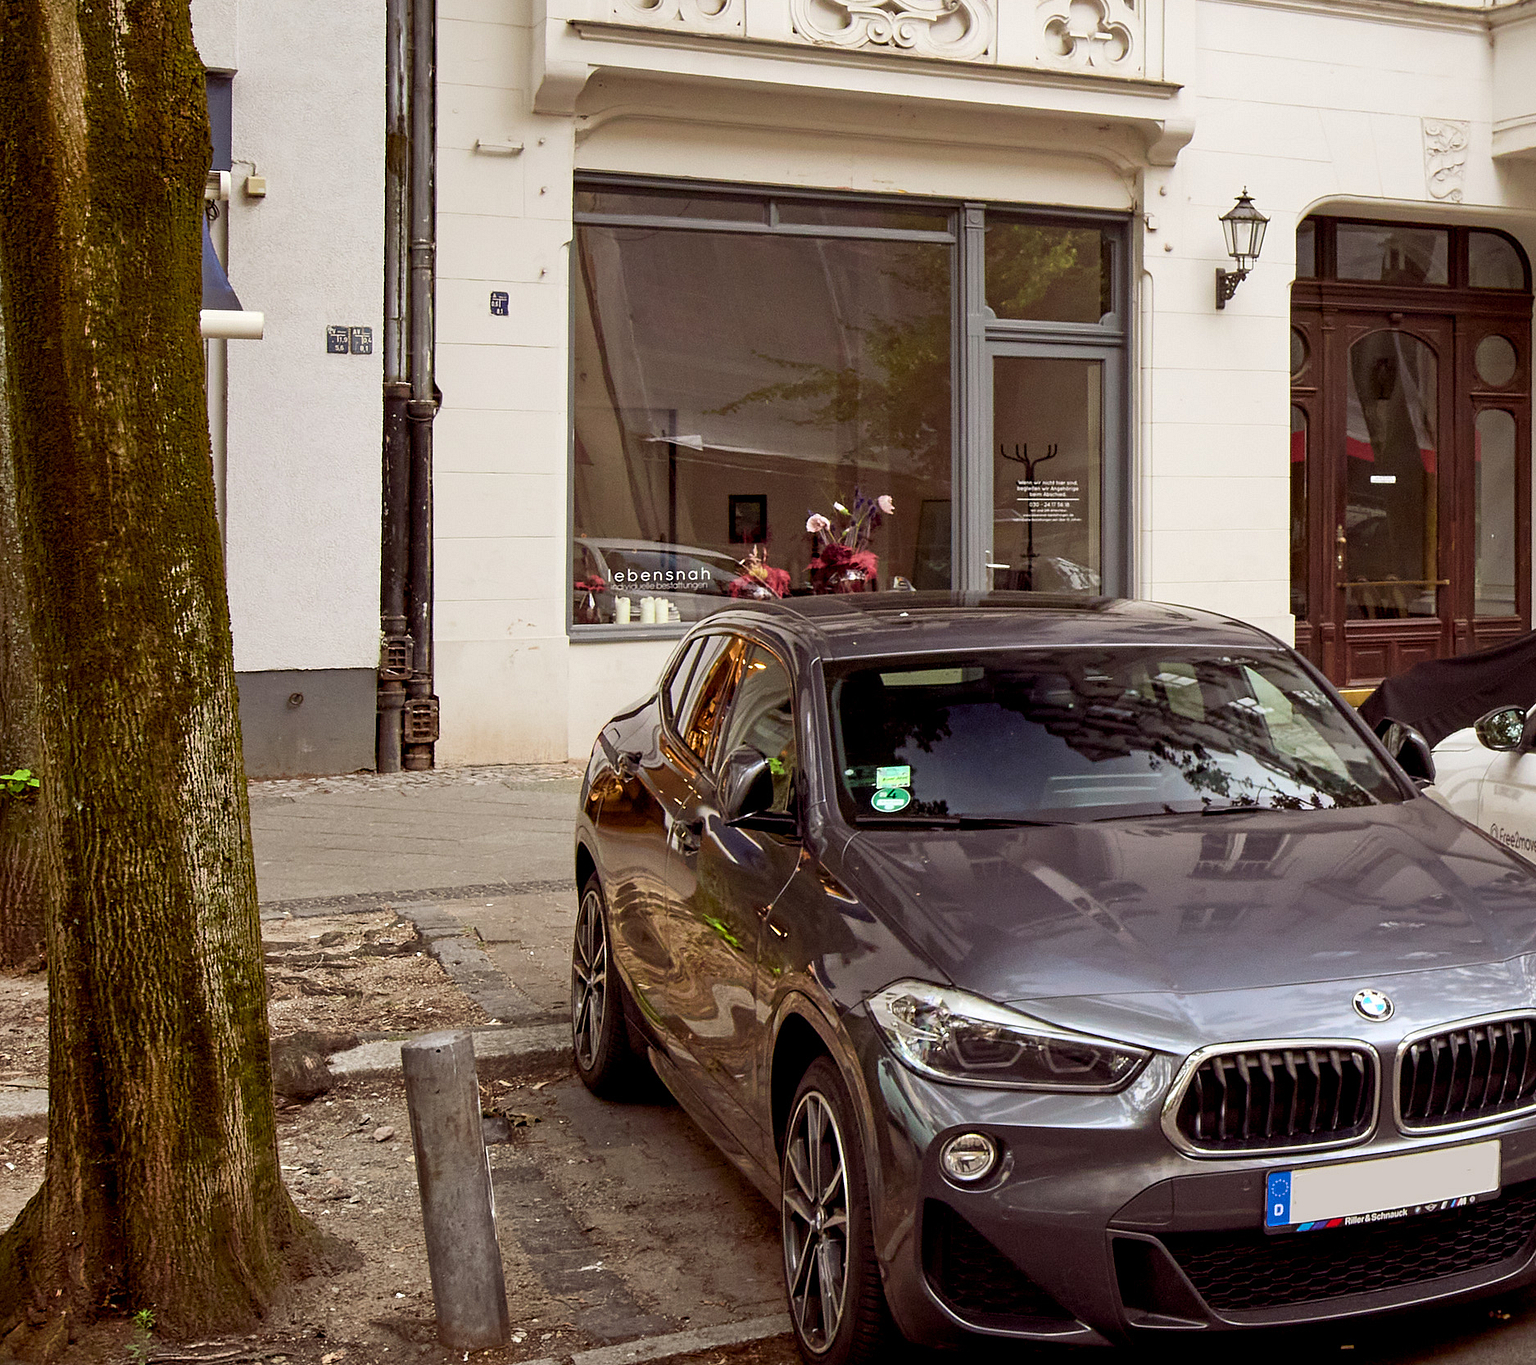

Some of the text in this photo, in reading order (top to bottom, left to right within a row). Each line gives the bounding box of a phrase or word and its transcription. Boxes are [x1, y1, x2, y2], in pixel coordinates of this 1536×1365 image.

[607, 567, 711, 582] lebensnah
[886, 788, 897, 799] 4
[1274, 1204, 1284, 1216] D
